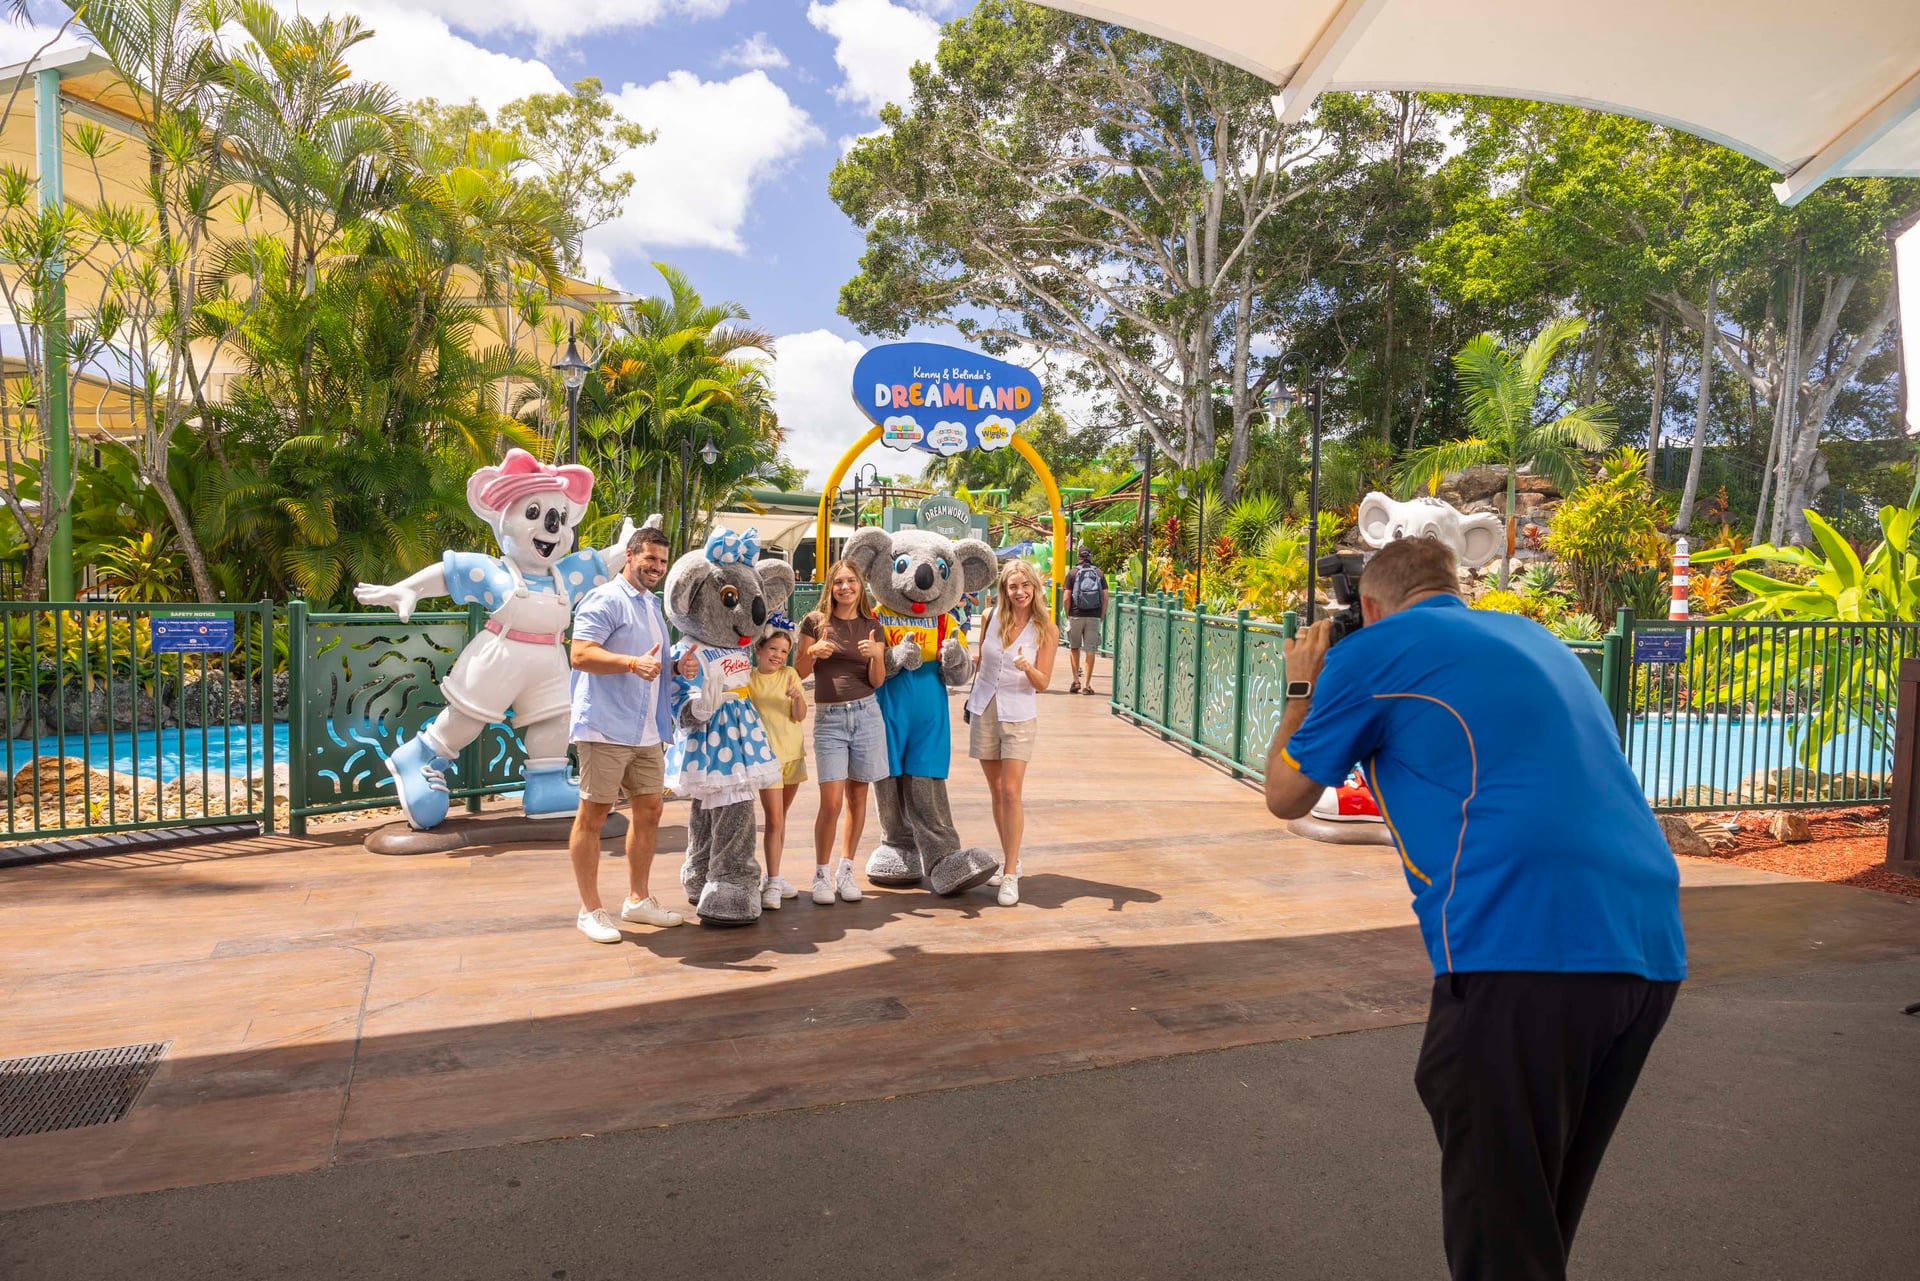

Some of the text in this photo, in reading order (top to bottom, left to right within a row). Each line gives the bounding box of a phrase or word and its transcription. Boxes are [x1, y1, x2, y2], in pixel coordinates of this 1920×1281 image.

[913, 366, 992, 384] Kenny & Belinda's
[874, 382, 1032, 411] DREAMLAND
[925, 505, 969, 524] DREAMWORLD
